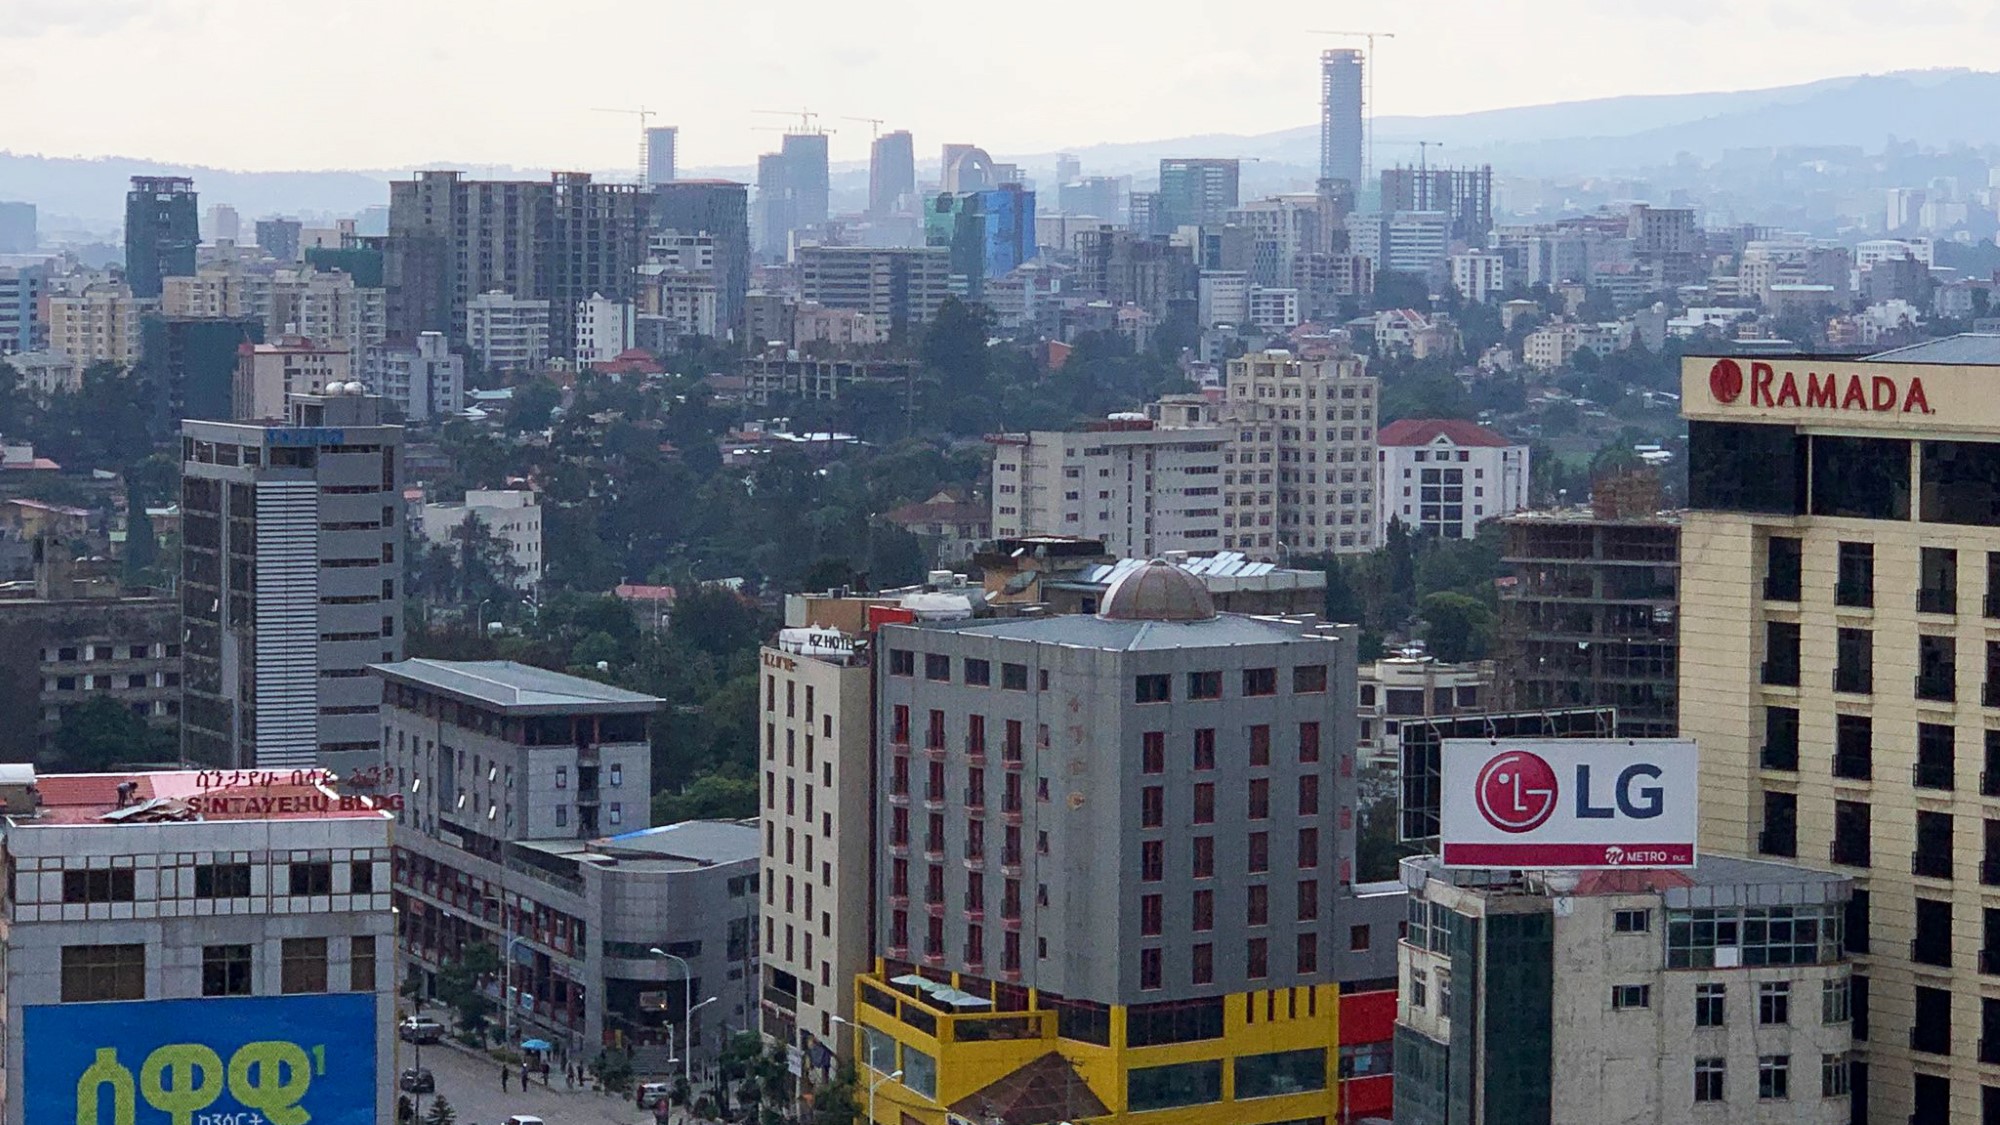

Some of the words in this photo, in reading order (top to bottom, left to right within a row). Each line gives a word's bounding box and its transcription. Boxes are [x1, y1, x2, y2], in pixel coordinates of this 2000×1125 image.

[1750, 361, 1930, 414] RAMADA
[339, 793, 404, 811] BLDG
[1576, 763, 1664, 820] LG
[1626, 851, 1668, 862] METRO
